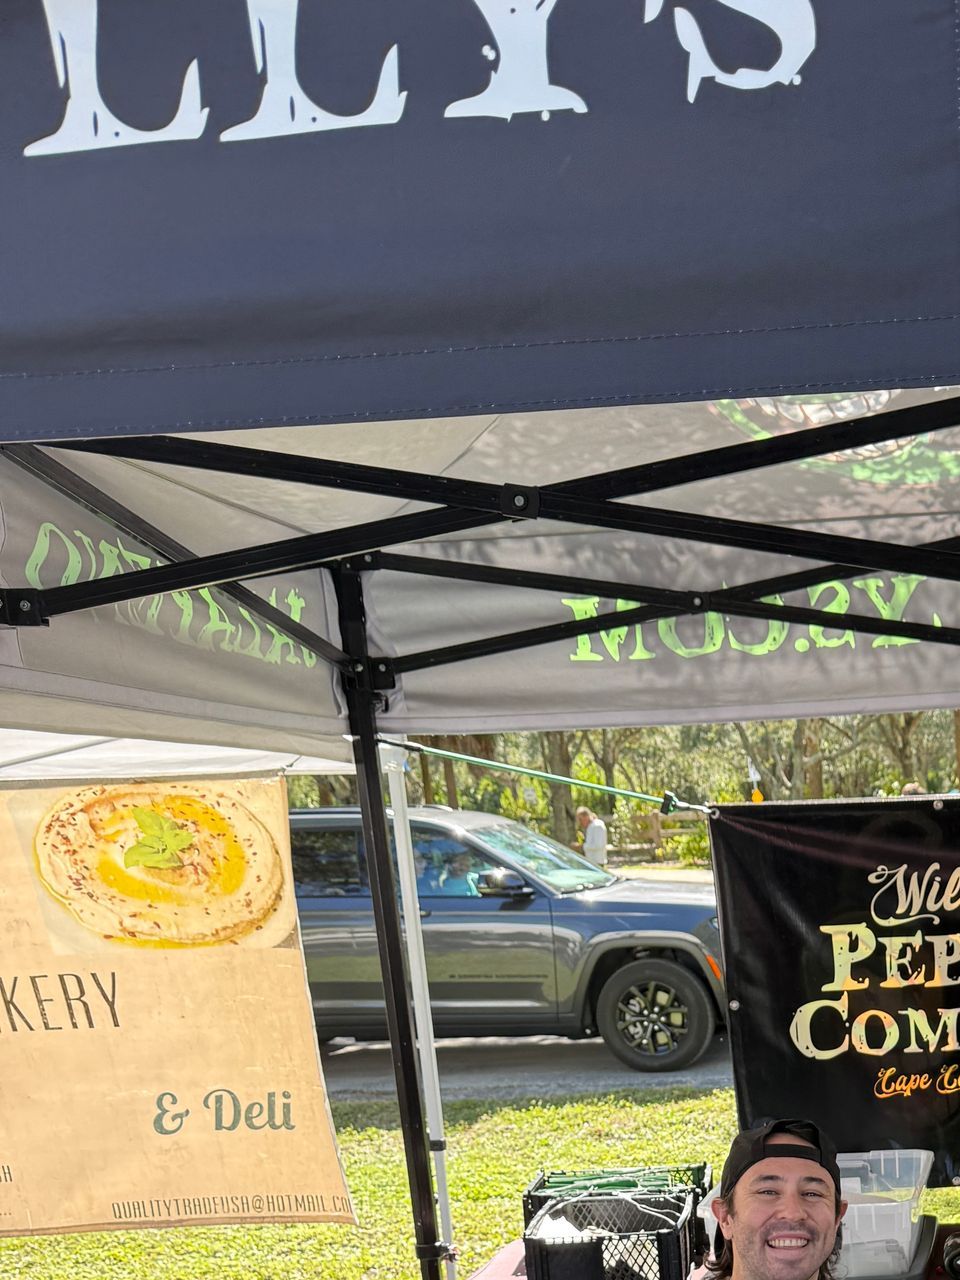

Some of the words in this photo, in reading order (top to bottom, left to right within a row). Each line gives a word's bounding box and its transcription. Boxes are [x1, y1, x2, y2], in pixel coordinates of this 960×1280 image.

[0, 972, 120, 1033] KERY
[873, 1066, 932, 1099] Cape
[153, 1092, 190, 1135] &
[203, 1088, 296, 1131] Deli
